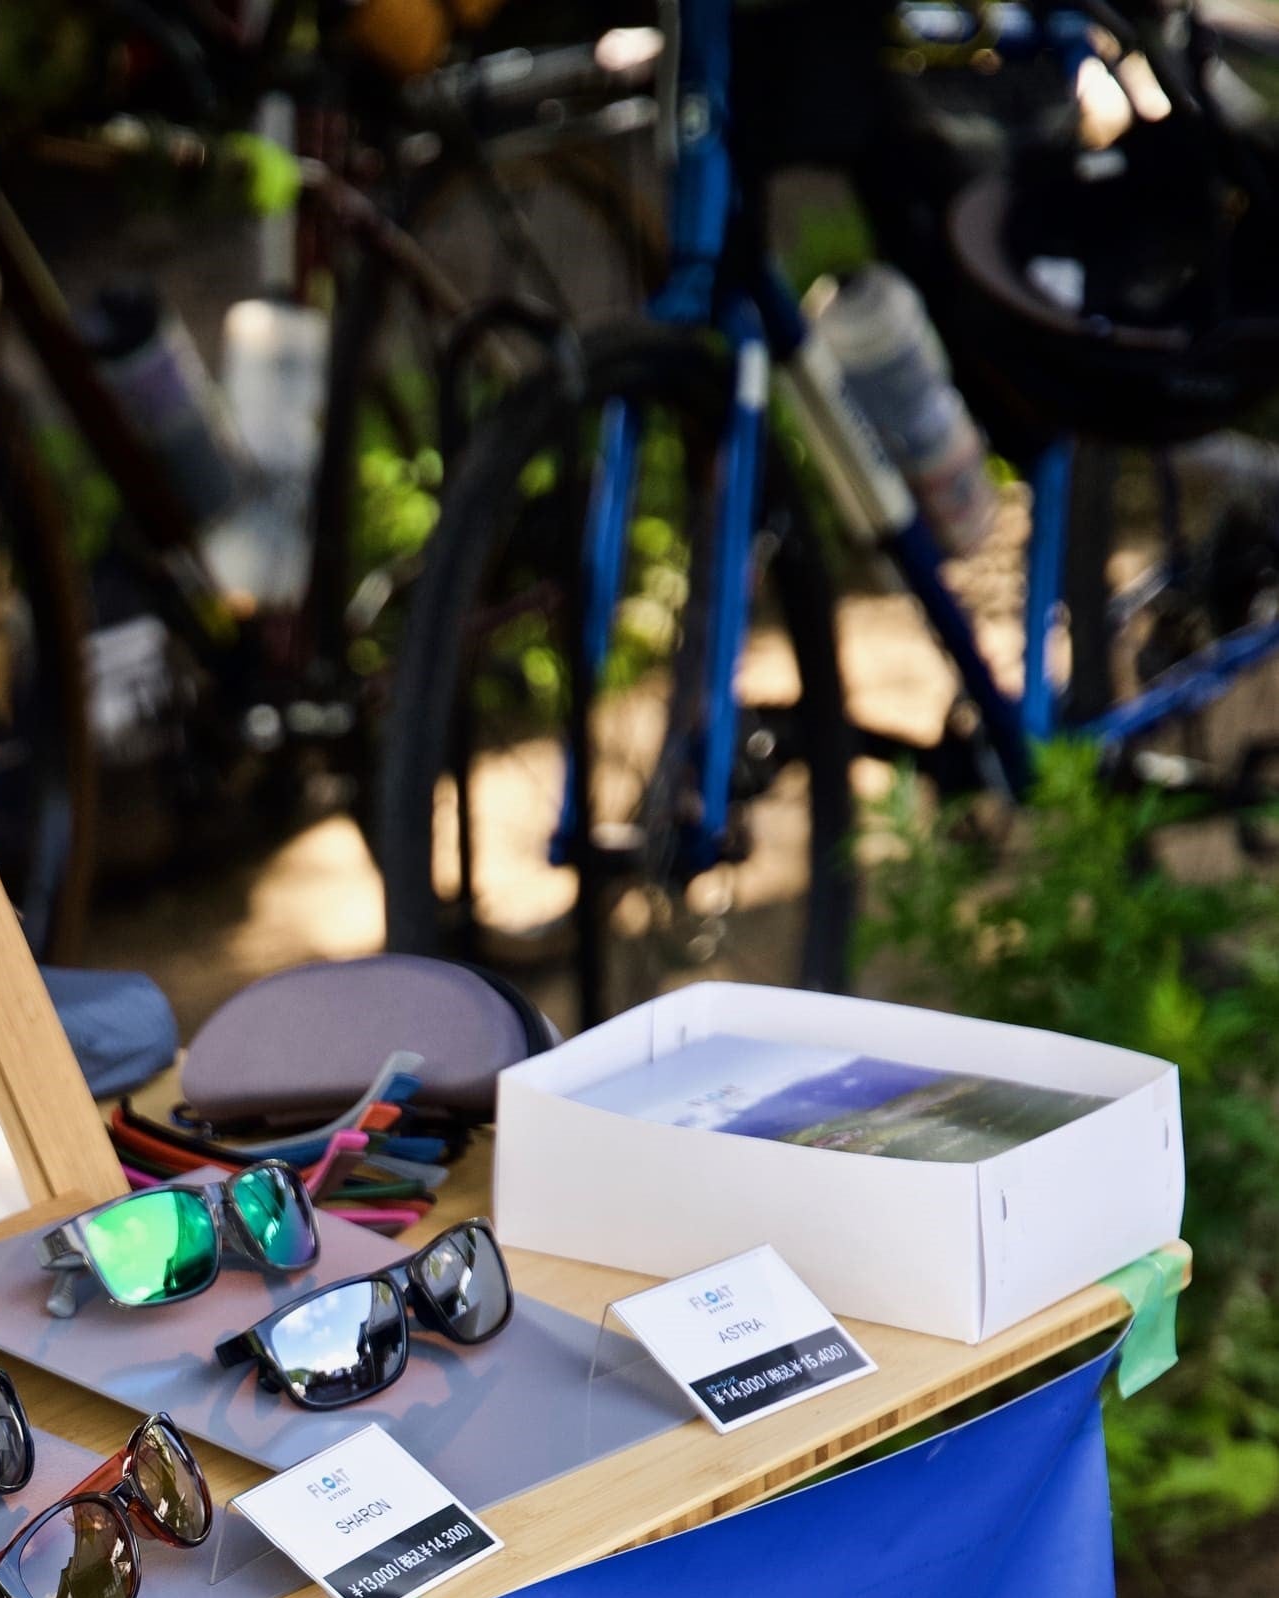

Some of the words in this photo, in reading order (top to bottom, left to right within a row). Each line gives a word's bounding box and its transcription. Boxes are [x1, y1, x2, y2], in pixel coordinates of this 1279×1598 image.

[688, 1284, 735, 1310] FLOAT
[718, 1317, 767, 1345] ASTRA
[306, 1467, 350, 1499] FLOAT
[335, 1498, 393, 1535] SHARON
